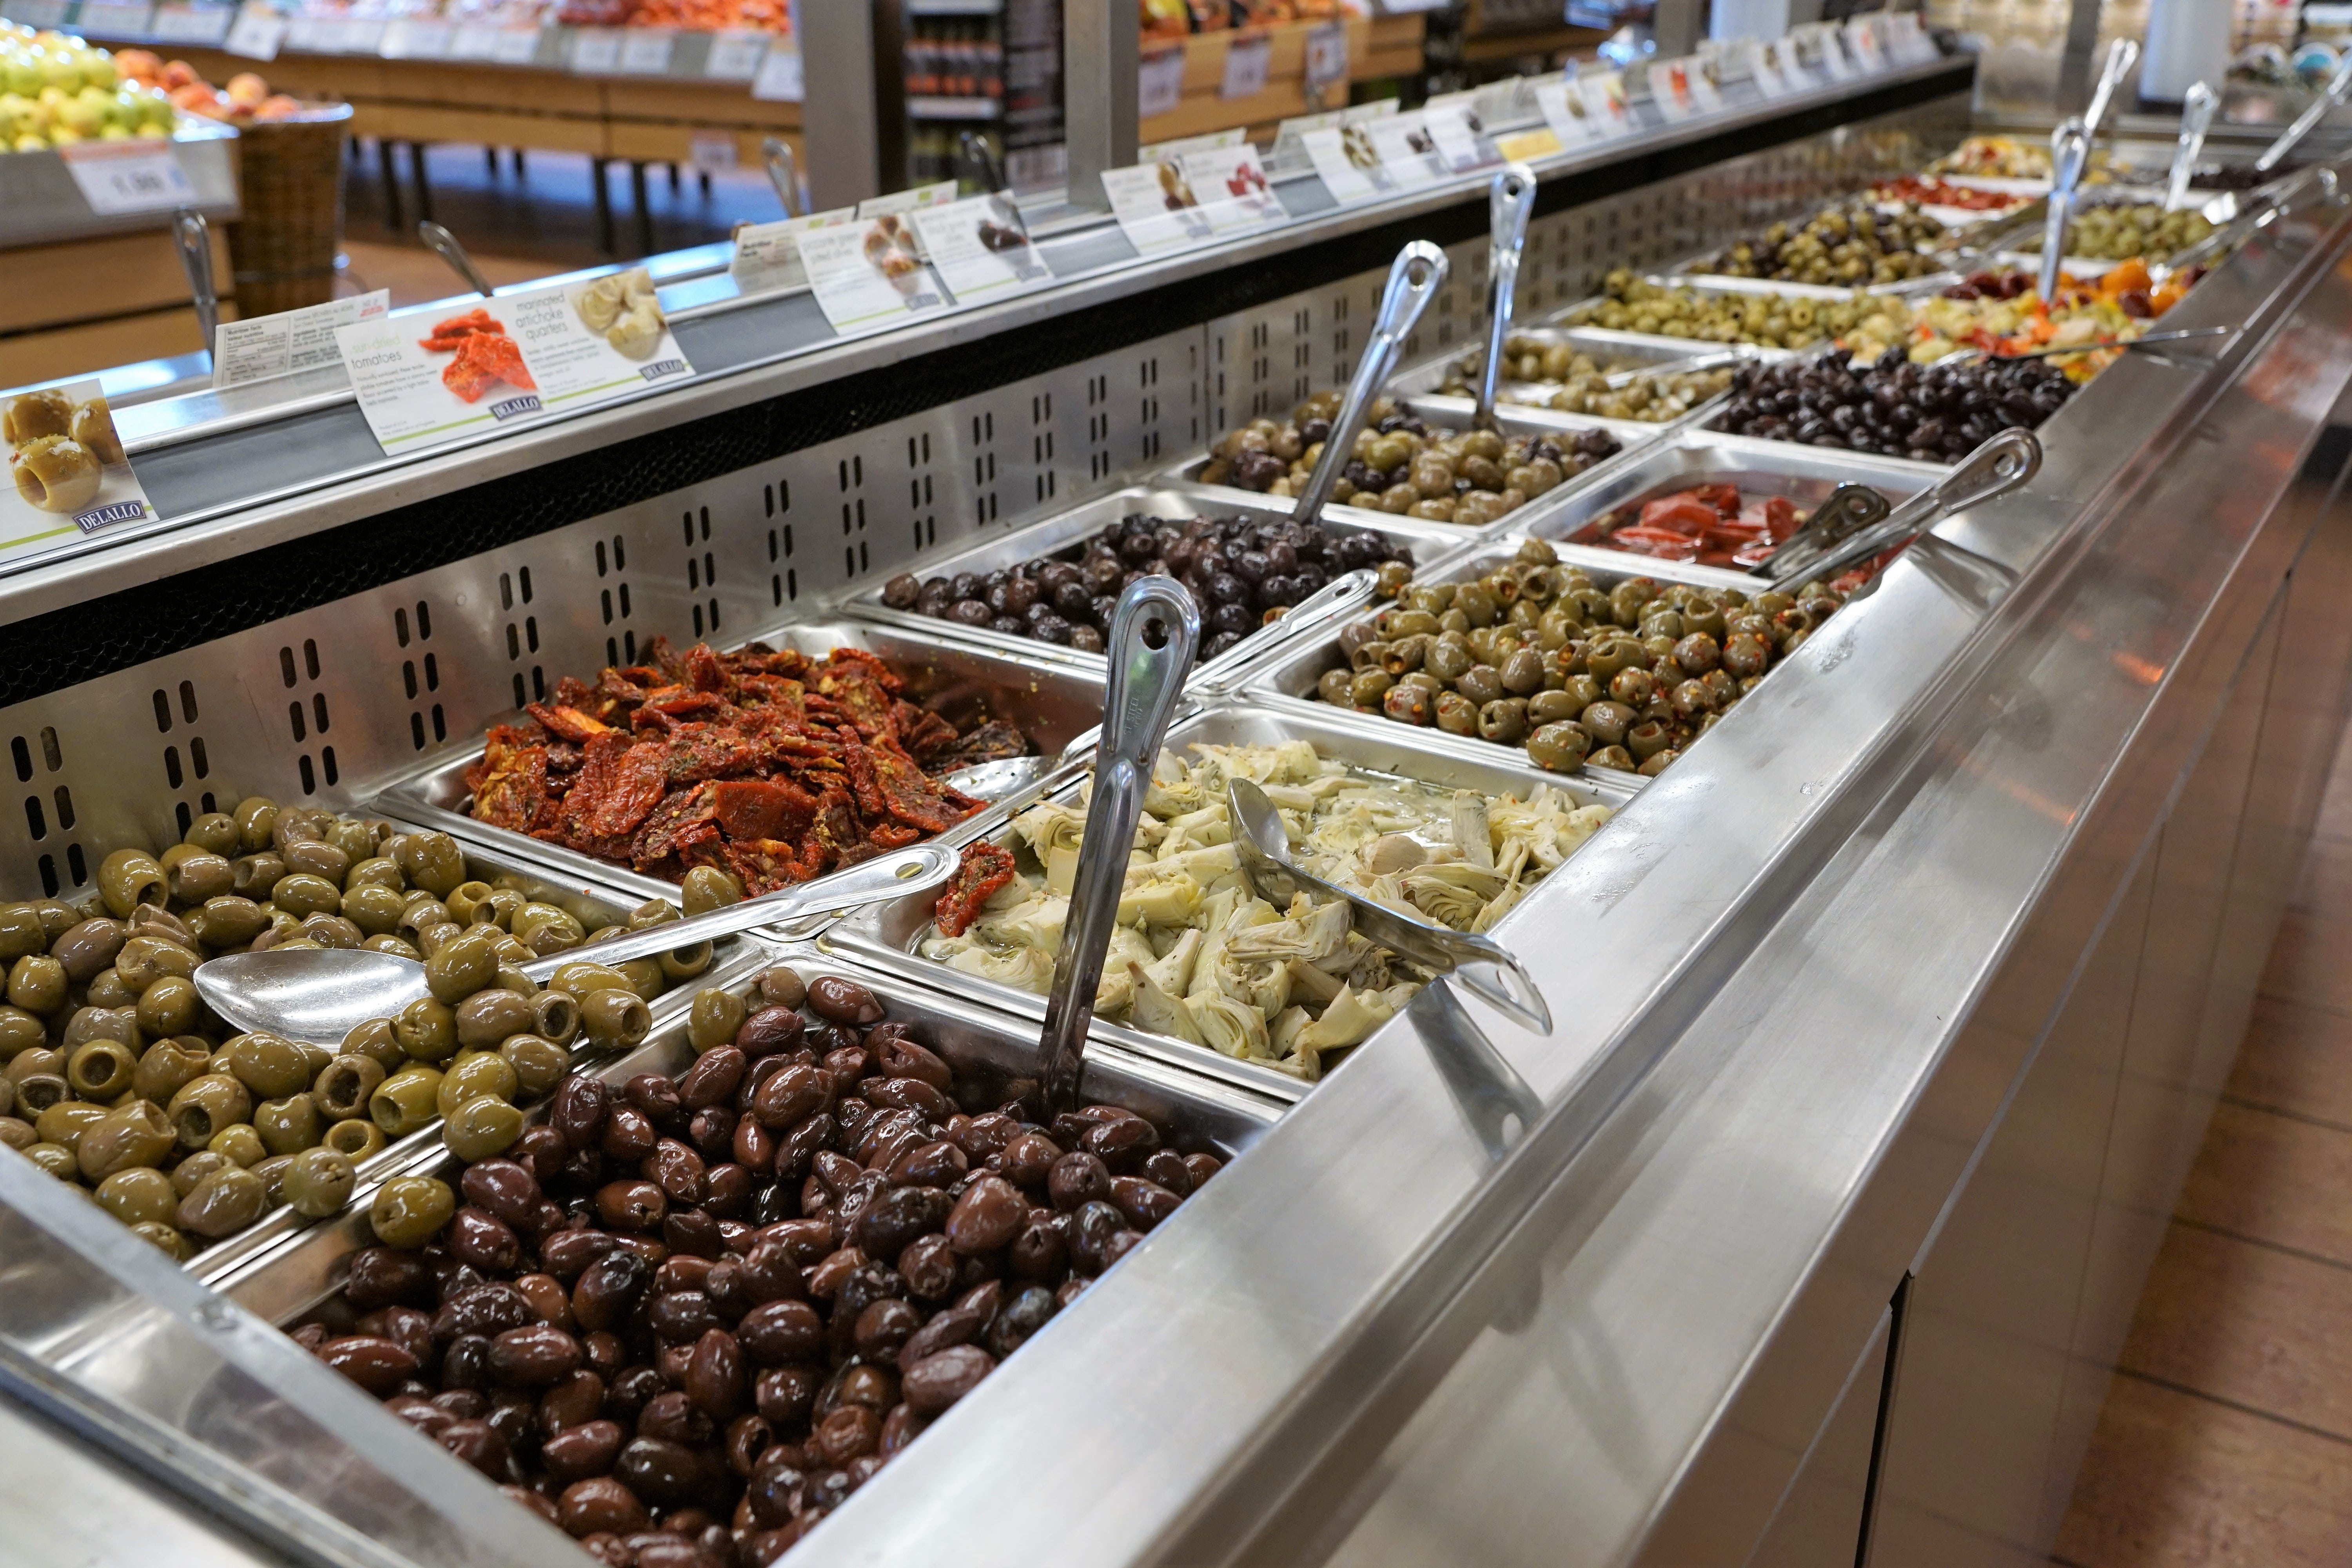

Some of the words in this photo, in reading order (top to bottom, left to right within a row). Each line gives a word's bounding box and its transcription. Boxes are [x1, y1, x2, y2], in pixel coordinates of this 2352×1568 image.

[517, 290, 565, 311] marinated
[515, 307, 564, 328] artichoke
[525, 322, 568, 342] quarters
[351, 351, 402, 369] tomatoes
[492, 396, 539, 418] DELALLO
[79, 504, 141, 530] DELALLO
